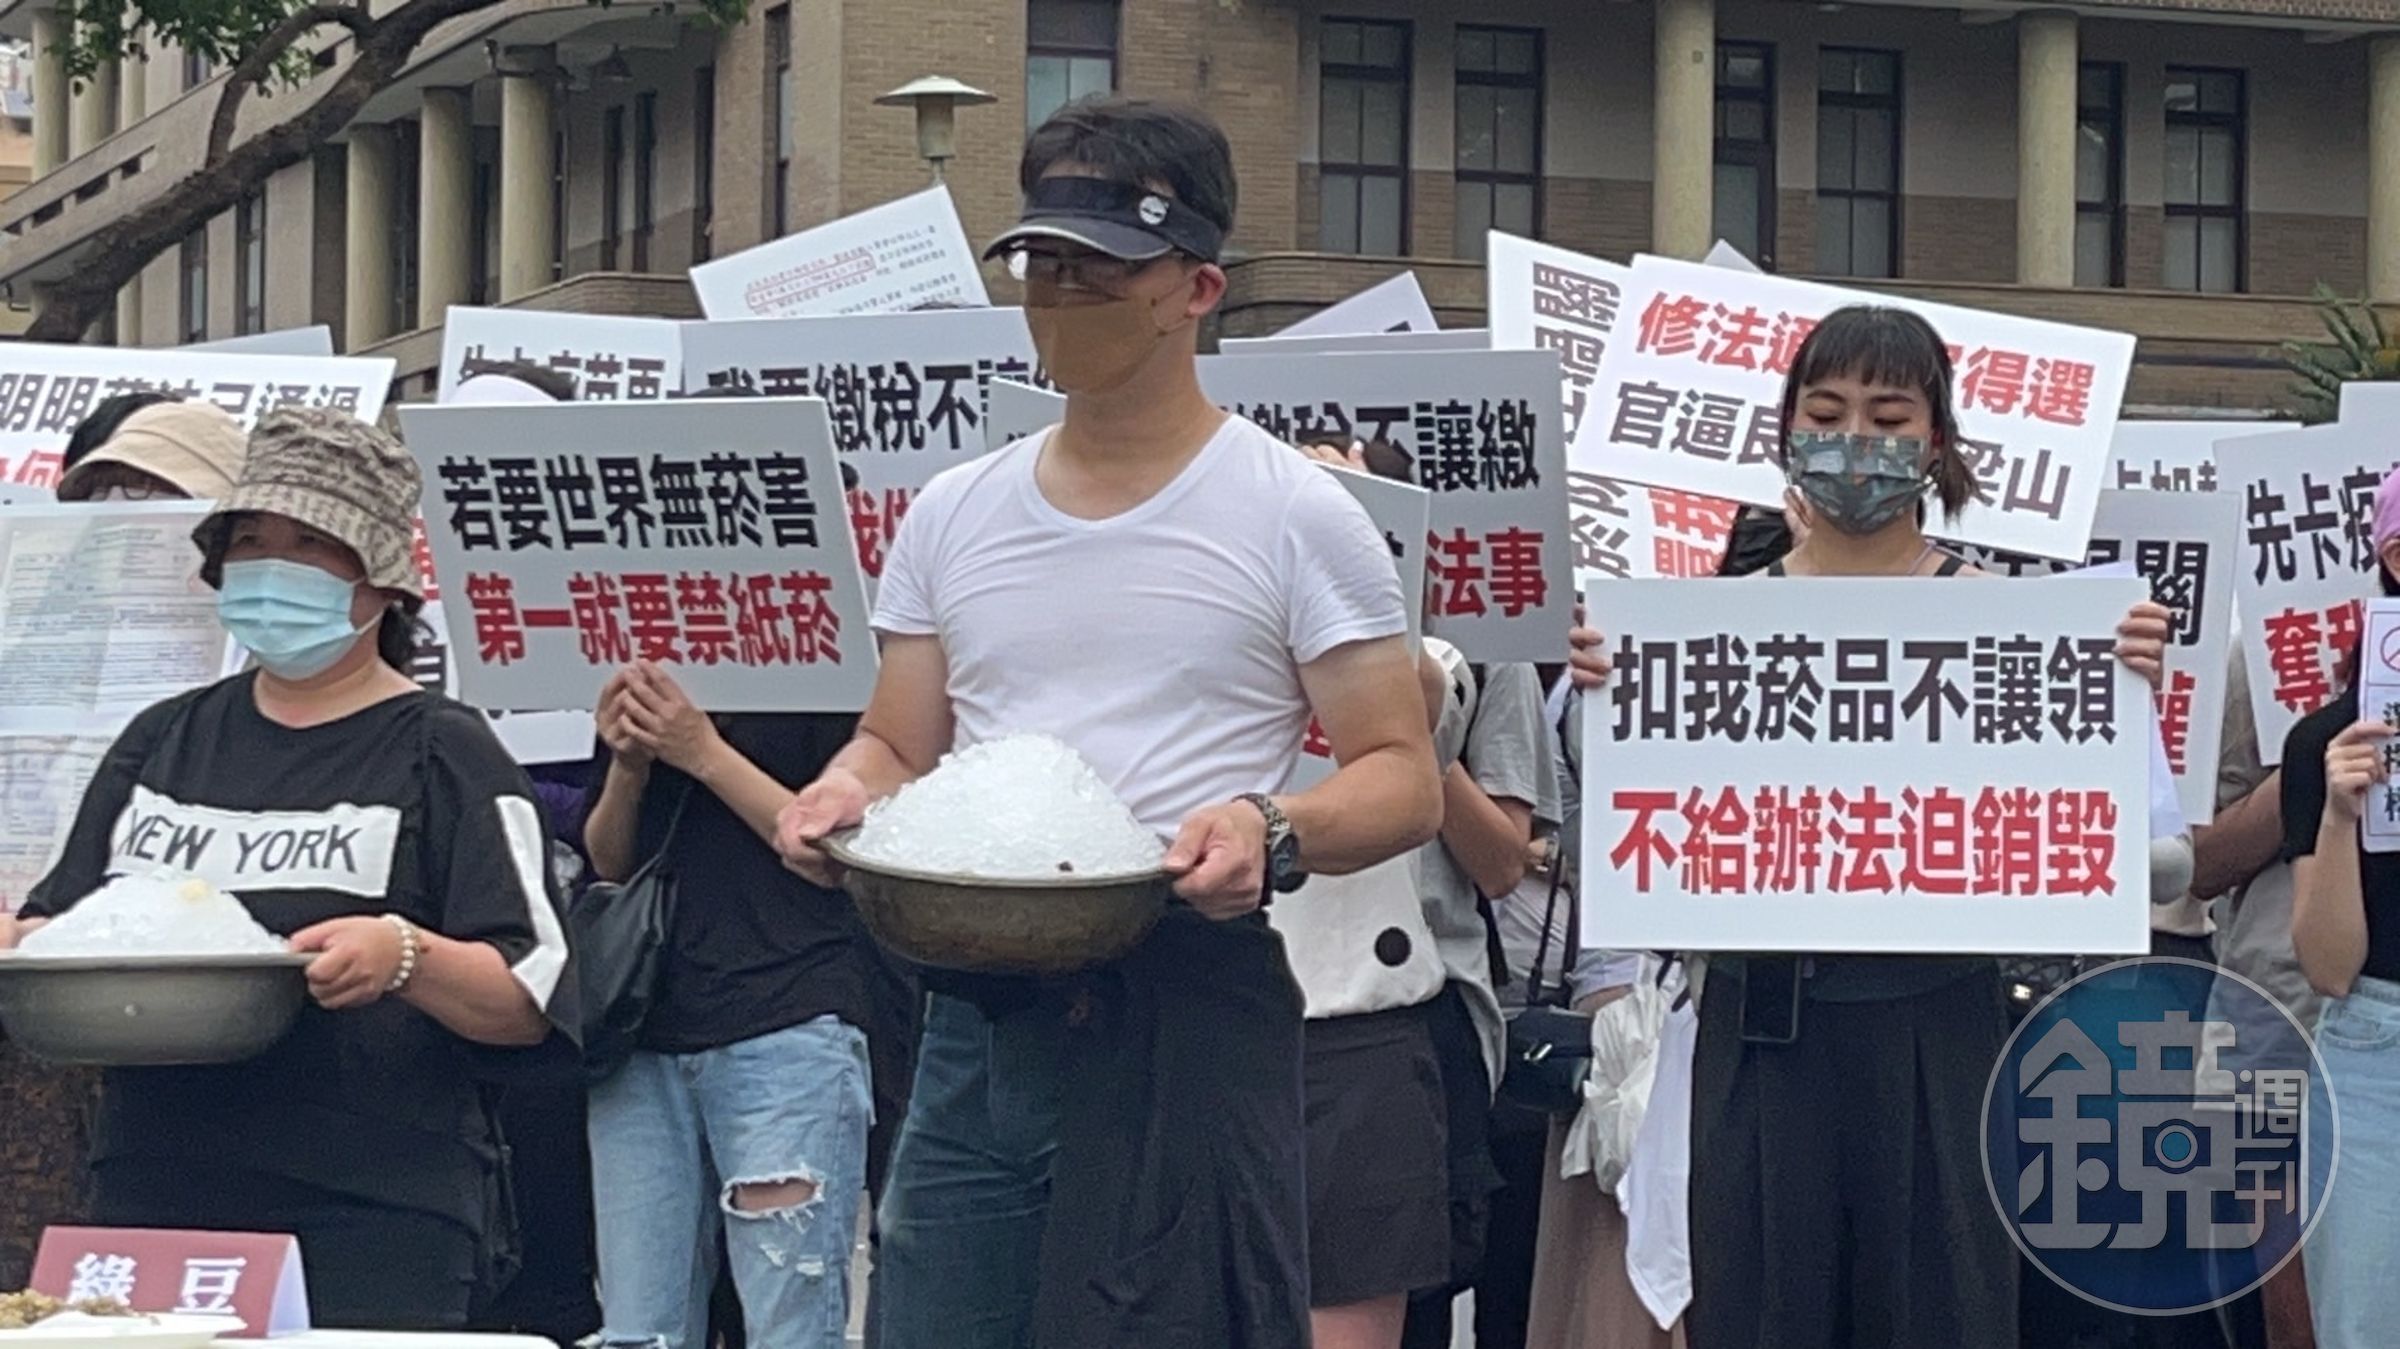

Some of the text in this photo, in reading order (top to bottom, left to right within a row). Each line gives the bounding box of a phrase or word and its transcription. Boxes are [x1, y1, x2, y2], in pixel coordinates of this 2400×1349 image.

[1636, 290, 2095, 427] 修法通得選
[438, 451, 819, 552] 若要世界無菸害
[465, 571, 842, 667] 第一就要禁紙菸
[1426, 526, 1547, 618] 法事
[1612, 633, 2118, 745] 扣我菸品不讓領
[118, 808, 362, 875] NEW YORK
[1610, 786, 2119, 897] 不給辦法迫銷毀
